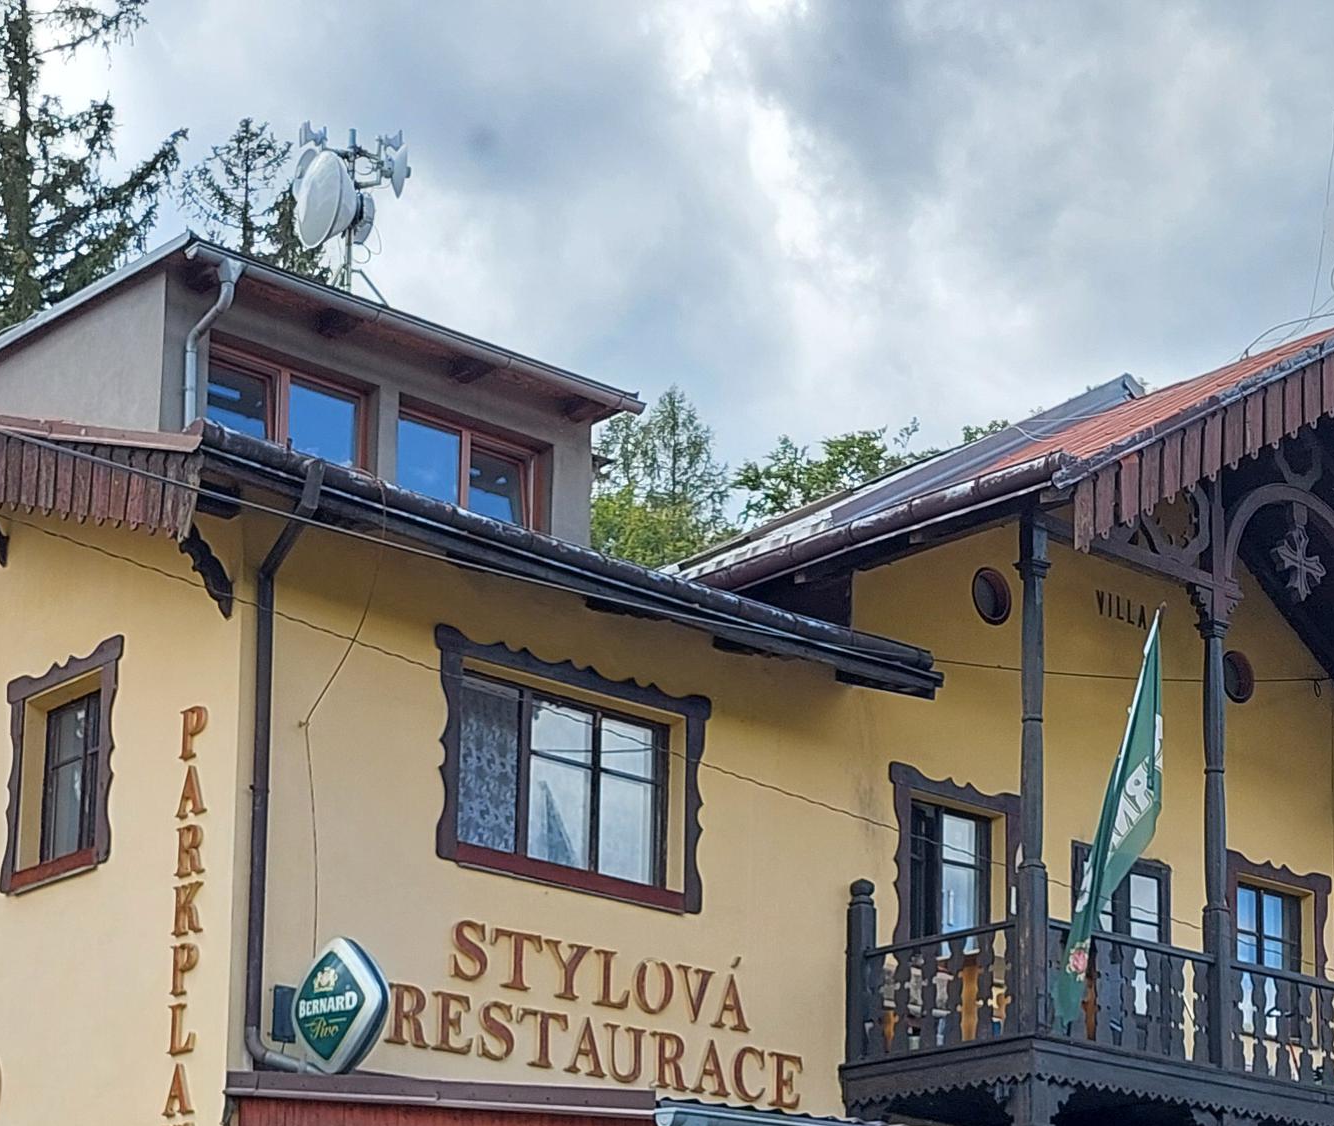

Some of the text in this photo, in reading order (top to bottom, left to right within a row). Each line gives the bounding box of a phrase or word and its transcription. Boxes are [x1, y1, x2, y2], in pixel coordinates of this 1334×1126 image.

[1095, 589, 1147, 631] VILLA
[298, 990, 358, 1019] BERNARD
[450, 919, 751, 1033] STYLOVÁ
[384, 982, 804, 1109] RESTAURACE
